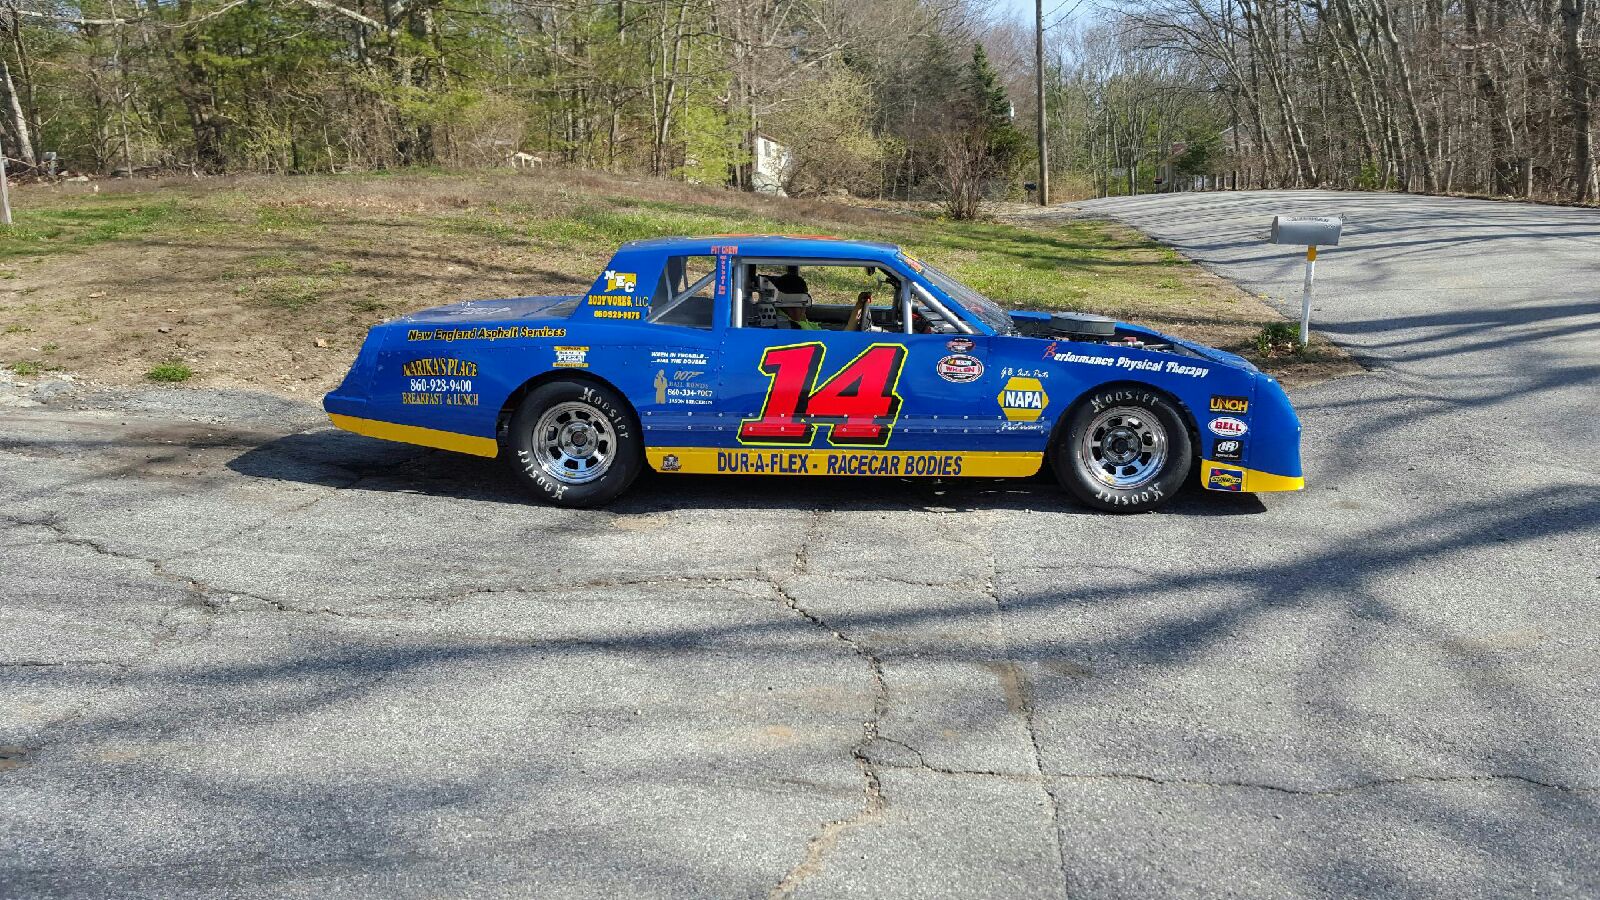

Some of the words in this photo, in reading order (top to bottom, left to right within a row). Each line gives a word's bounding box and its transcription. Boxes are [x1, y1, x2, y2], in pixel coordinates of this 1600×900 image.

[604, 270, 635, 293] NEC
[635, 296, 649, 308] LLC
[408, 329, 432, 342] New
[434, 327, 477, 343] England
[479, 326, 519, 342] Asphalt
[521, 326, 567, 338] Services
[403, 358, 446, 377] MARIKA'S
[448, 358, 478, 377] PLACE
[674, 370, 705, 381] 007
[1116, 356, 1164, 373] Physical
[1166, 361, 1209, 378] Therapy
[410, 378, 472, 392] 860-928-9400
[402, 392, 443, 405] BREAKFAST
[453, 393, 479, 406] LUNCH
[736, 341, 909, 447] 14
[1005, 391, 1042, 409] NAPA
[1210, 398, 1248, 411] UNOH
[1215, 421, 1242, 432] BELL
[717, 452, 809, 473] DUR-A-FLEX
[827, 453, 900, 475] RACECAR
[904, 455, 963, 476] BODIES
